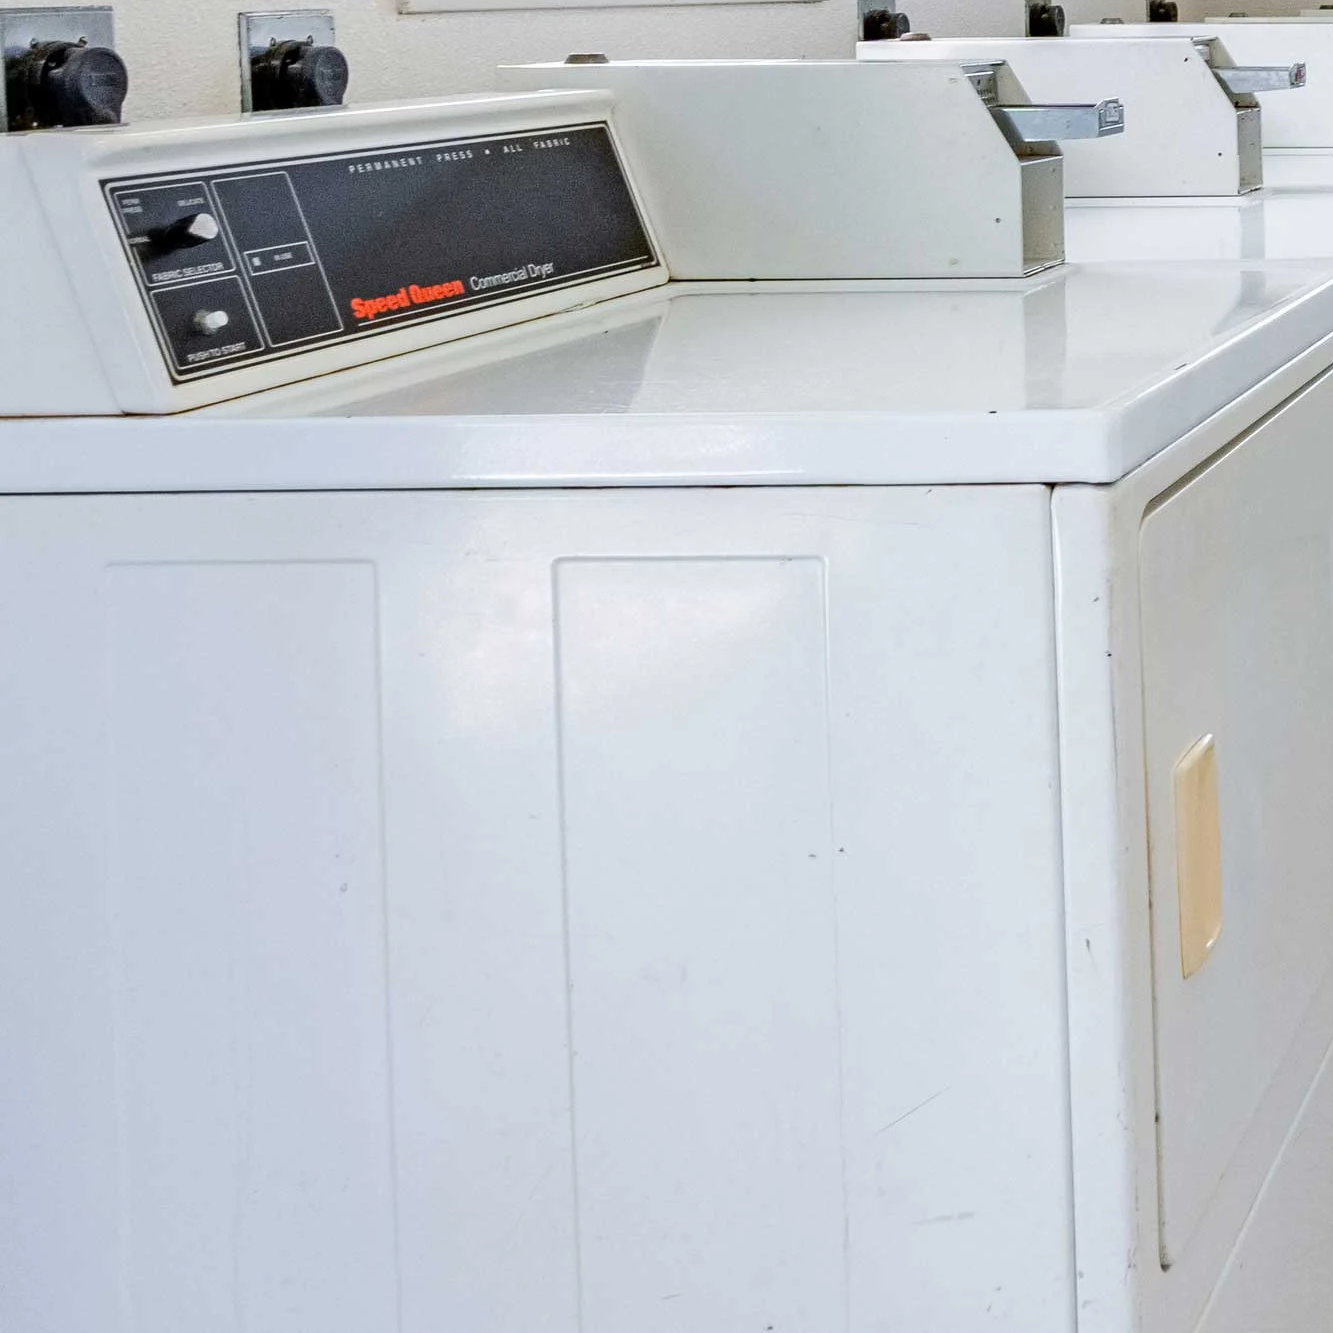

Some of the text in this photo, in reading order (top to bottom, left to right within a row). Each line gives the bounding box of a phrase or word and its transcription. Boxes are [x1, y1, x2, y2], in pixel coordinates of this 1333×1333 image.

[349, 137, 571, 175] PERMANENT PRESS ALL FABRIC
[152, 262, 224, 282] FABRIC SELECTOR
[351, 261, 555, 320] Speed Queen Commercial Dryer
[187, 342, 246, 362] PUSH TO START
